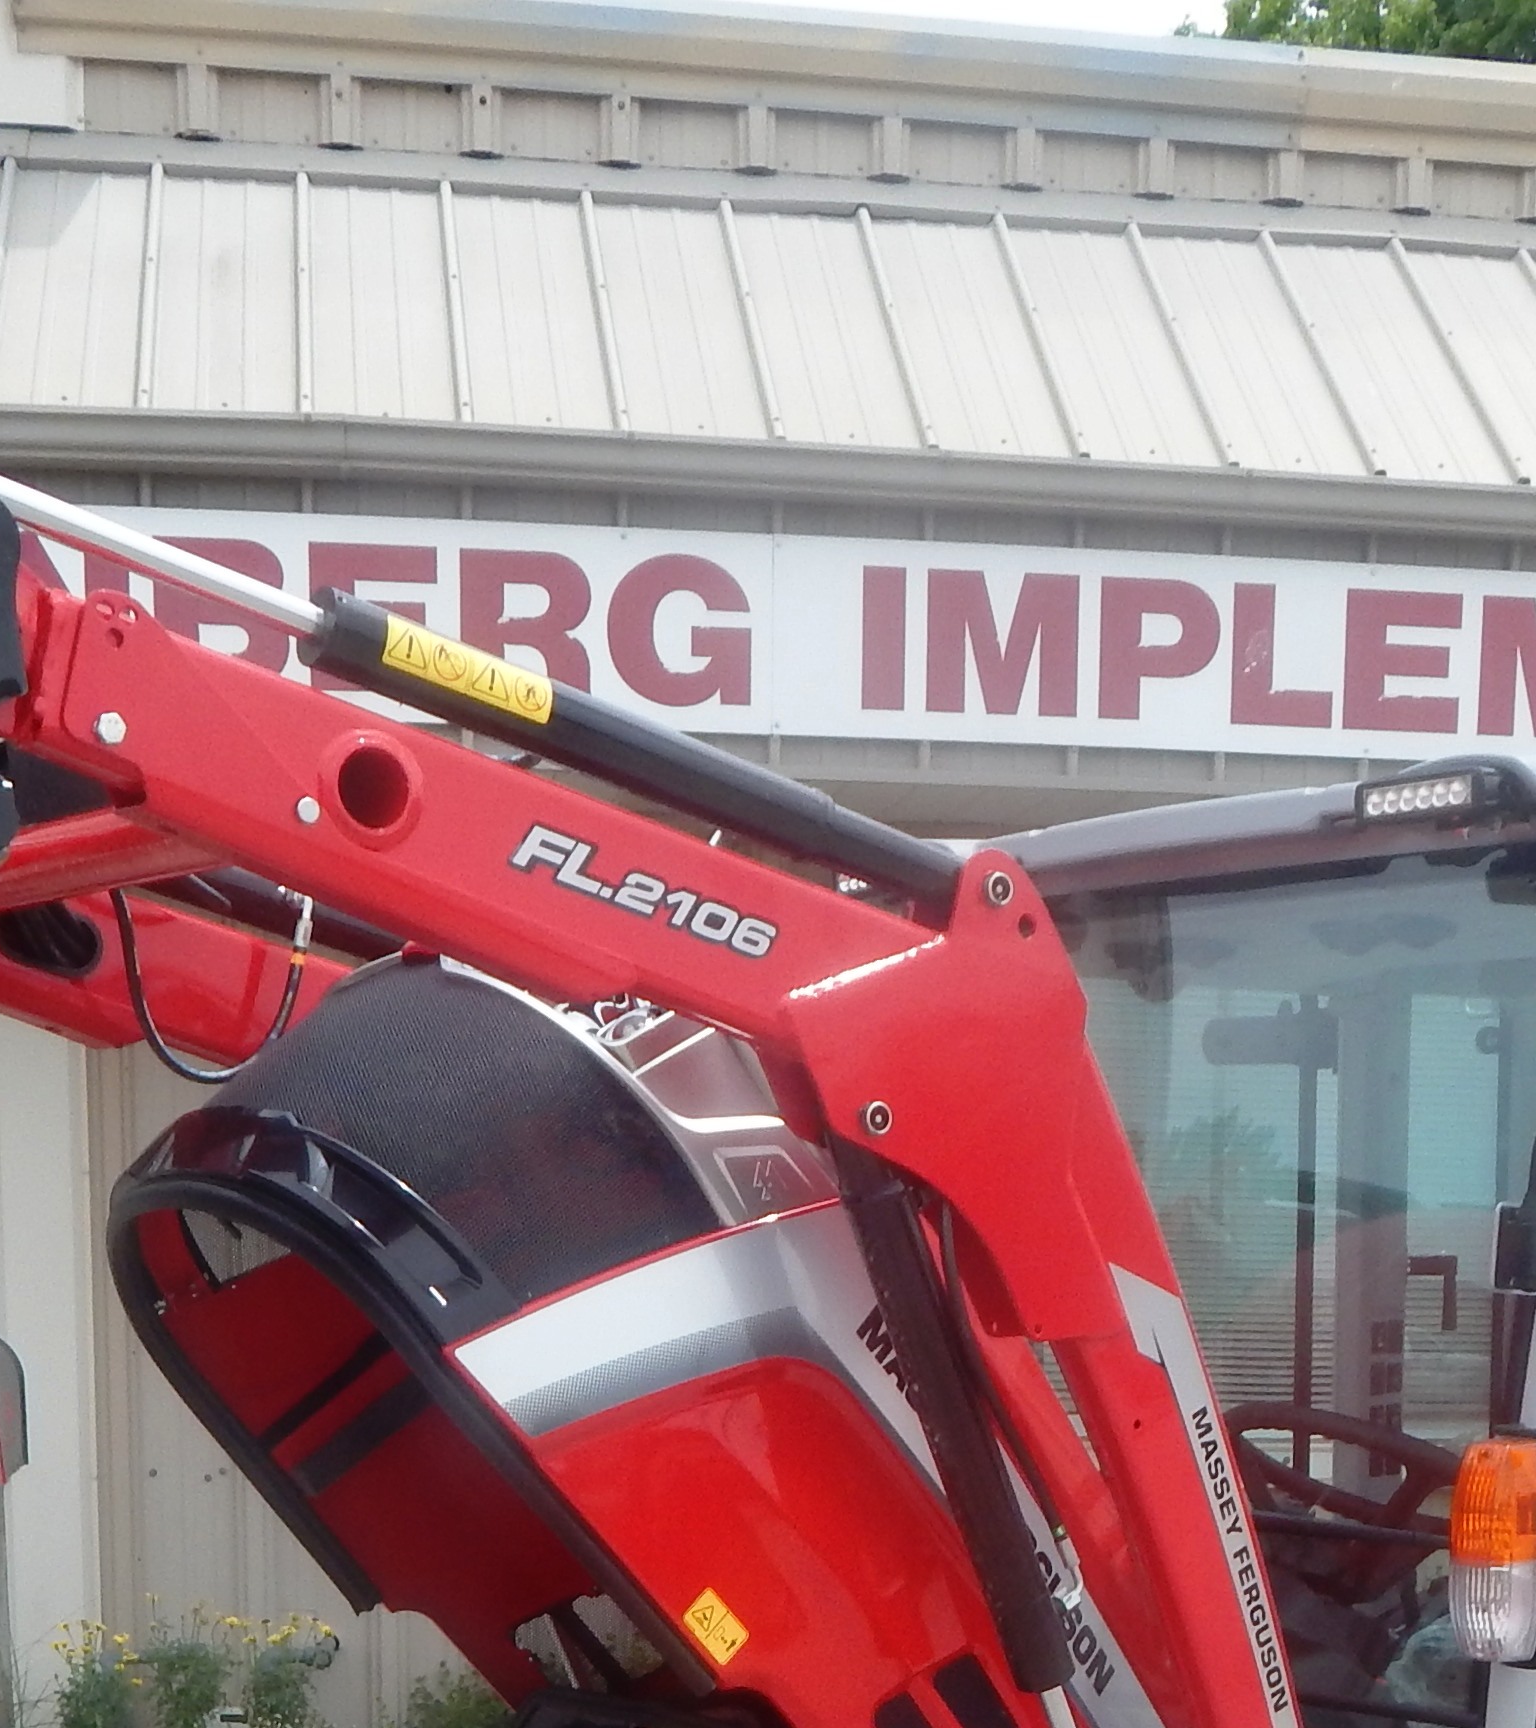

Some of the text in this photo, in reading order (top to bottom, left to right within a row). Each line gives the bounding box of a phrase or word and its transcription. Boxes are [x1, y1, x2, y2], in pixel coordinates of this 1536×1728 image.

[510, 822, 780, 958] FL.2106
[1192, 1406, 1289, 1713] MASSEY FERGUSON
